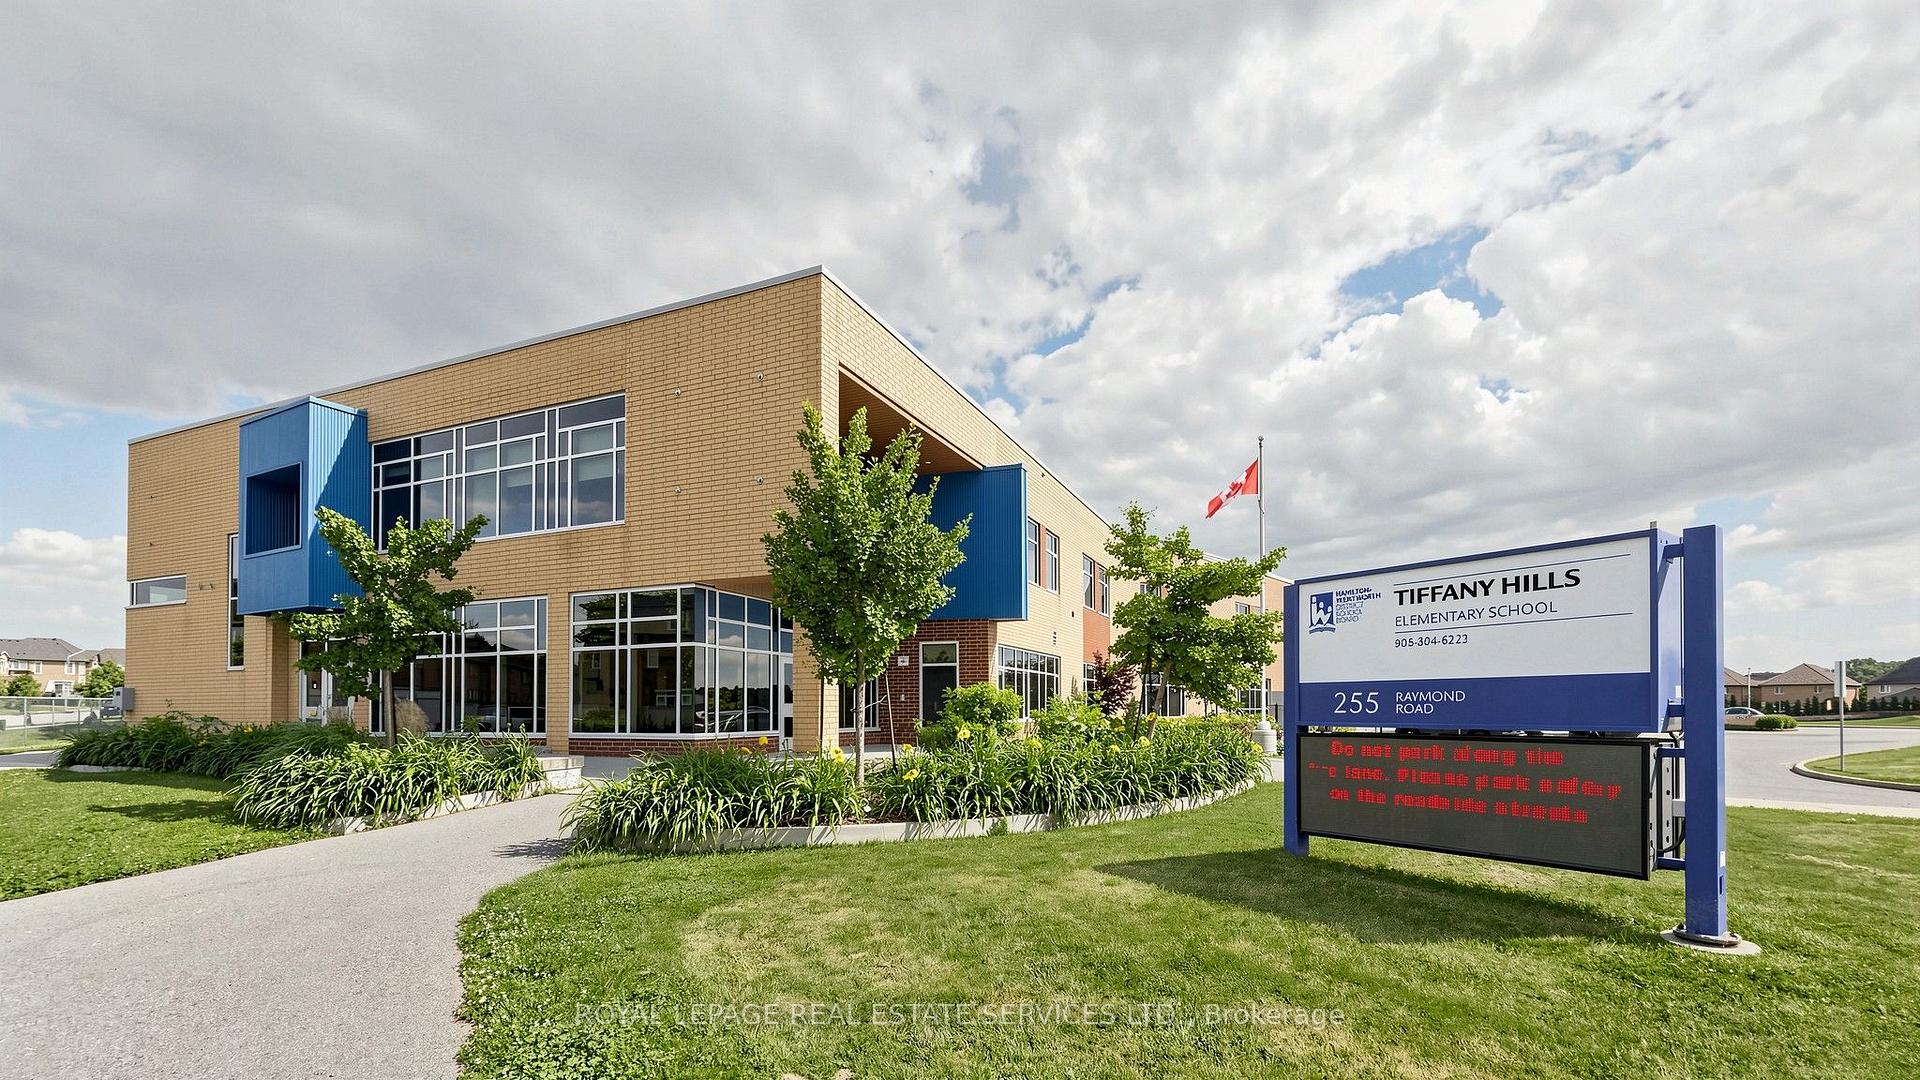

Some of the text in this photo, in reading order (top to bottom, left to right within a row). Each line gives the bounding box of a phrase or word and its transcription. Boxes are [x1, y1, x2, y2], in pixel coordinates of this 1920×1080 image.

[1393, 568, 1581, 606] TIFFANY HILLS
[1395, 601, 1558, 627] ELEMENTARY SCHOOL
[1394, 634, 1468, 649] 905-304-6223
[1333, 691, 1379, 714] 255
[1395, 690, 1466, 702] RAYMOND
[1395, 703, 1434, 715] ROAD
[1330, 740, 1354, 758] Do
[1361, 743, 1392, 759] not
[1399, 744, 1445, 761] park
